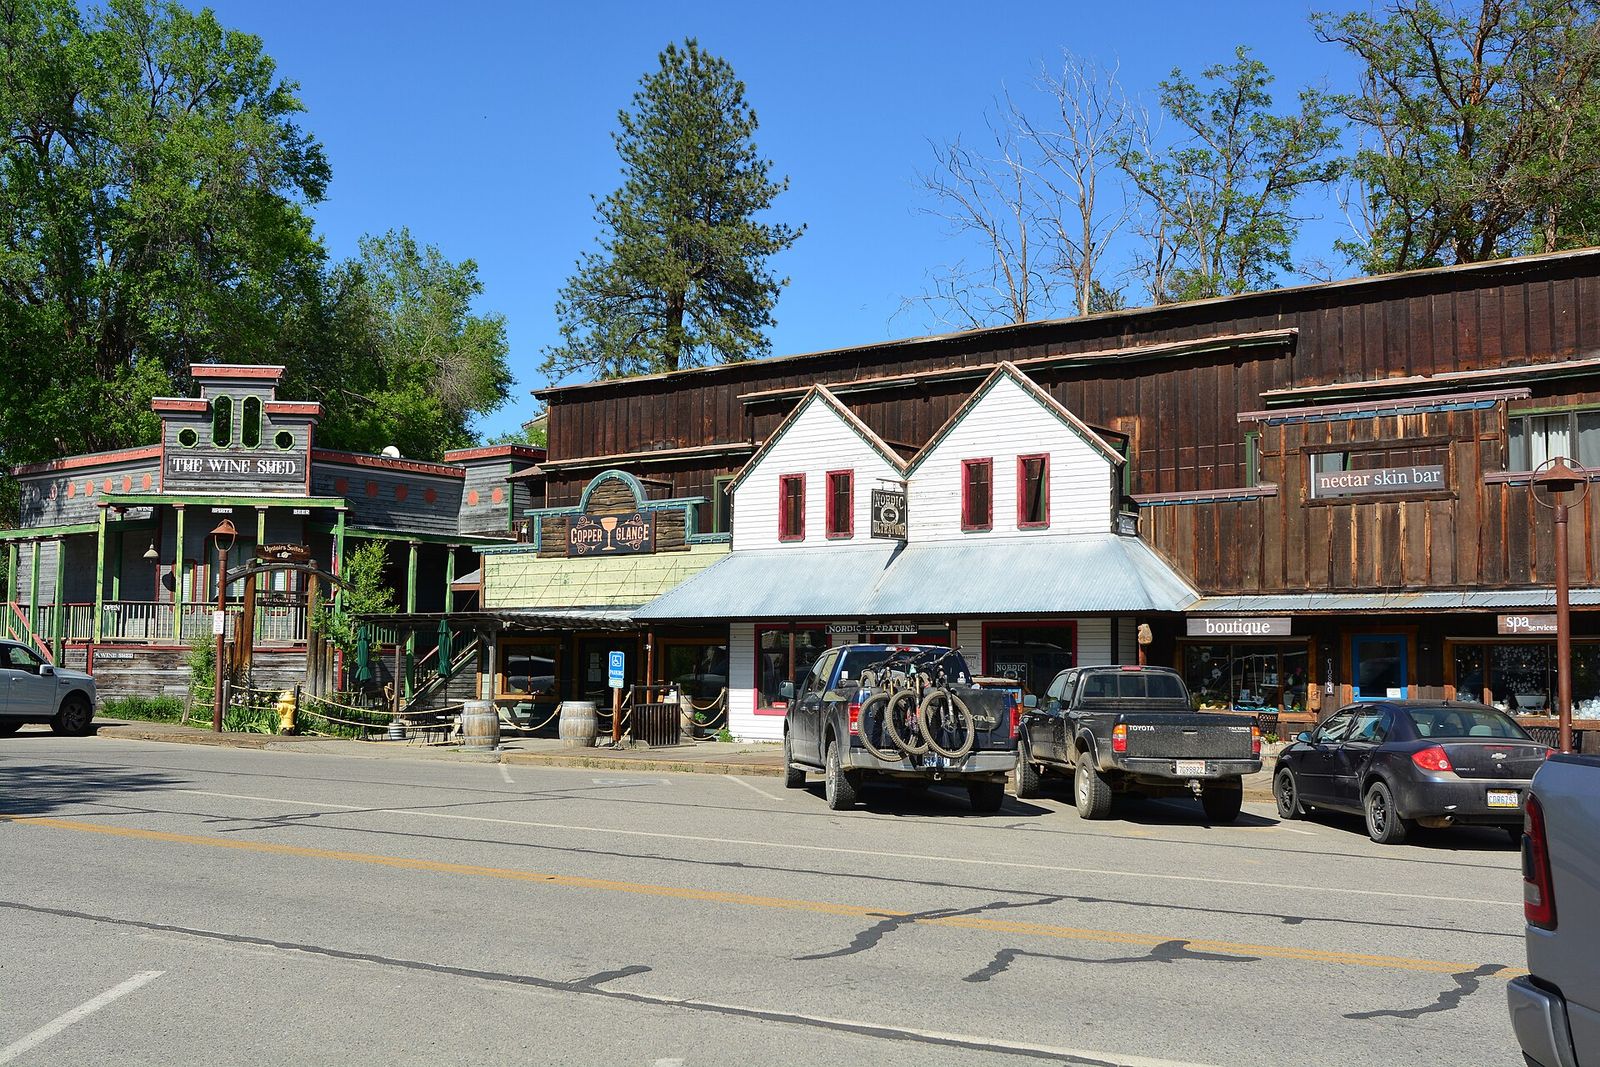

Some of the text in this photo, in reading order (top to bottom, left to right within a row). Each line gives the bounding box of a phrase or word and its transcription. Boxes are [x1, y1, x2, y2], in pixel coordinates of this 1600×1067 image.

[173, 458, 296, 474] THE WINE SHED
[1320, 468, 1440, 489] nectar skin bar
[874, 492, 904, 510] NORDIC
[570, 524, 650, 544] COPPER GLANCE
[829, 625, 861, 633] NORDIC
[1204, 618, 1271, 636] boutique
[1506, 616, 1529, 632] spa
[996, 664, 1026, 672] NORDIC
